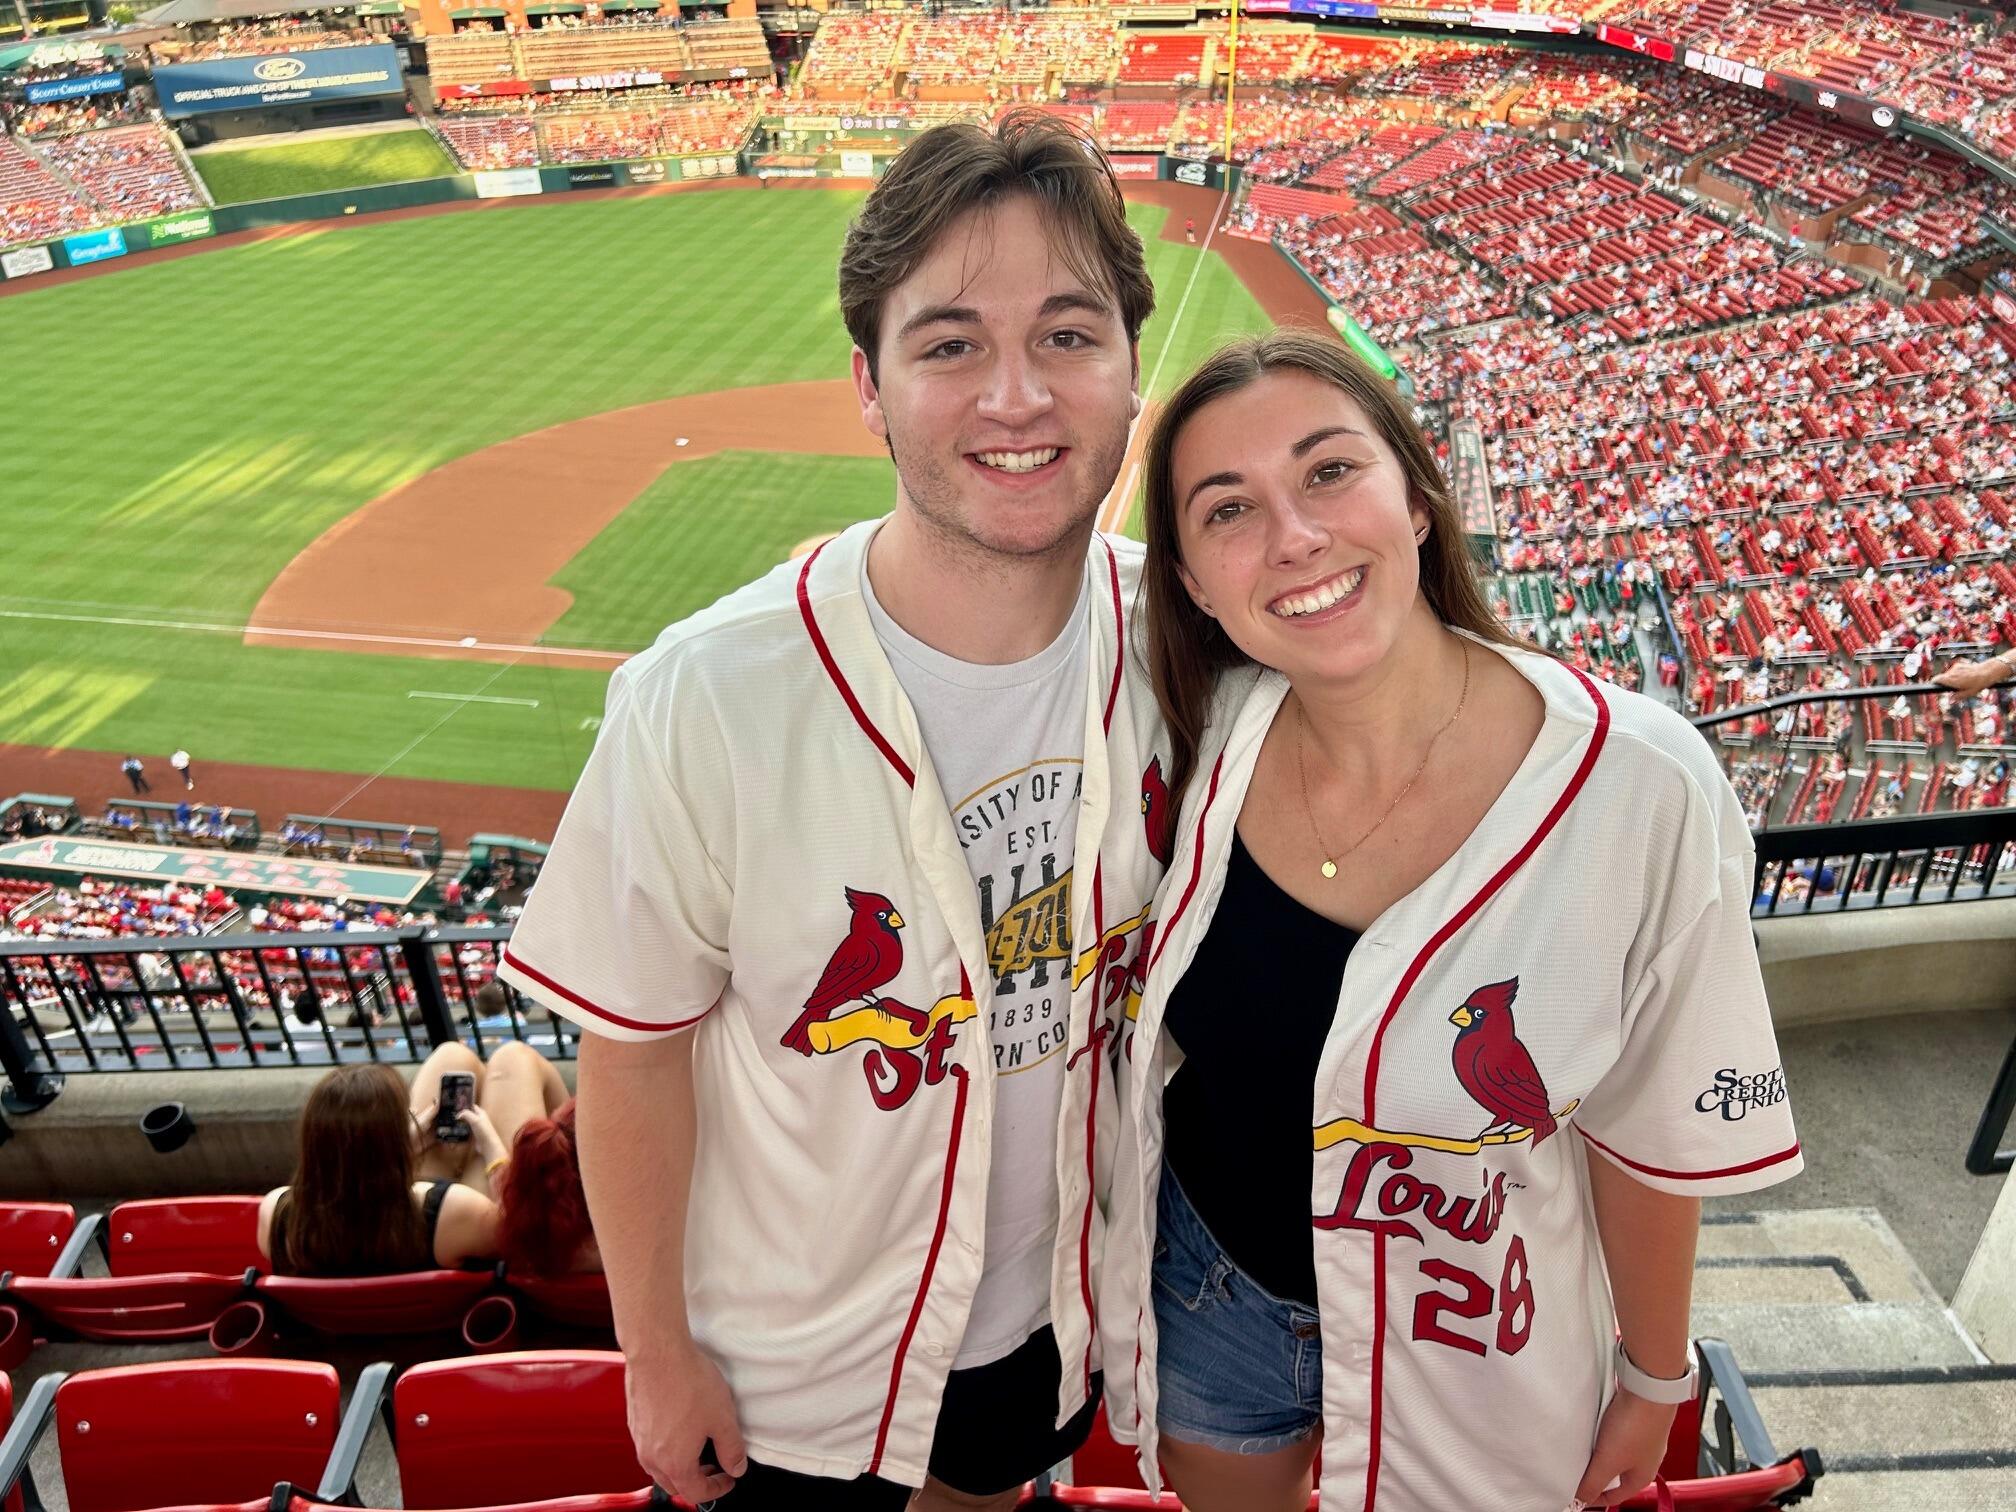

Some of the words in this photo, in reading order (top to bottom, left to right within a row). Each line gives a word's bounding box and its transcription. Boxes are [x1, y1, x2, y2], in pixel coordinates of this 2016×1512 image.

[1031, 771, 1062, 802] OF
[1007, 820, 1057, 854] EST.
[990, 998, 1052, 1031] 1839
[1038, 1013, 1071, 1055] CO
[1721, 1088, 1786, 1121] UNIO
[1412, 1234, 1535, 1358] 28
